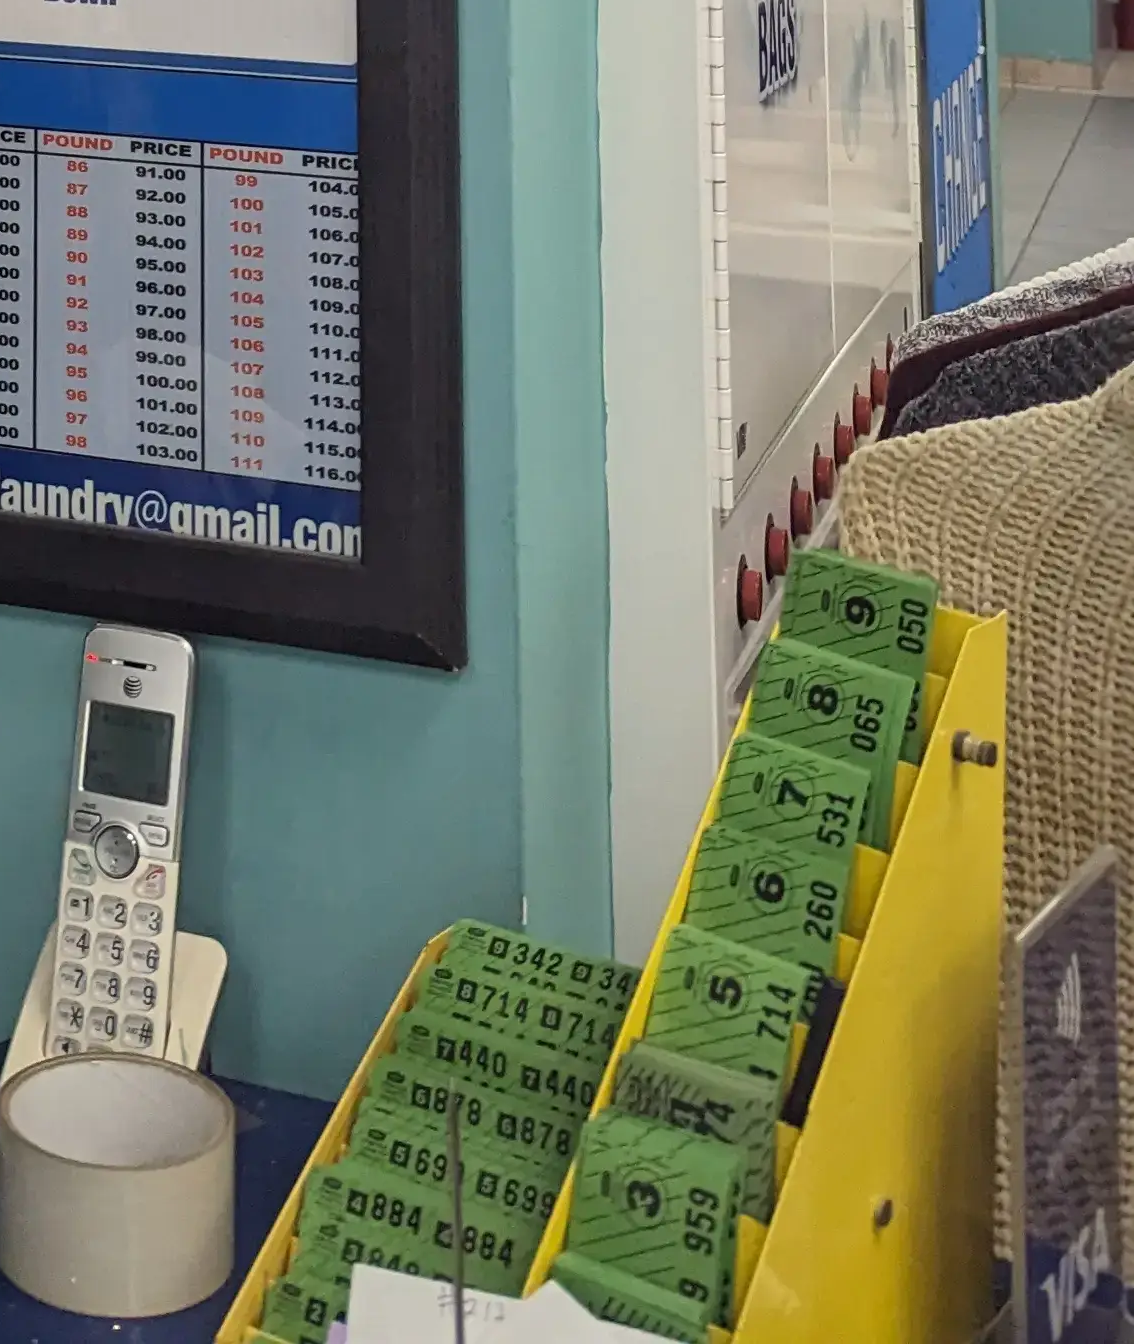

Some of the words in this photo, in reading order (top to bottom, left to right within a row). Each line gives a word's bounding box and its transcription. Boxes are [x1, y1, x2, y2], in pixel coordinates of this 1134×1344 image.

[896, 597, 930, 656] 050
[849, 693, 886, 755] 065
[817, 791, 857, 849] 531
[803, 880, 839, 943] 260
[513, 942, 564, 977] 342
[483, 984, 530, 1024] 714
[757, 983, 798, 1045] 714
[461, 1039, 508, 1078] 440
[370, 1192, 423, 1236] 884
[684, 1187, 723, 1259] 959
